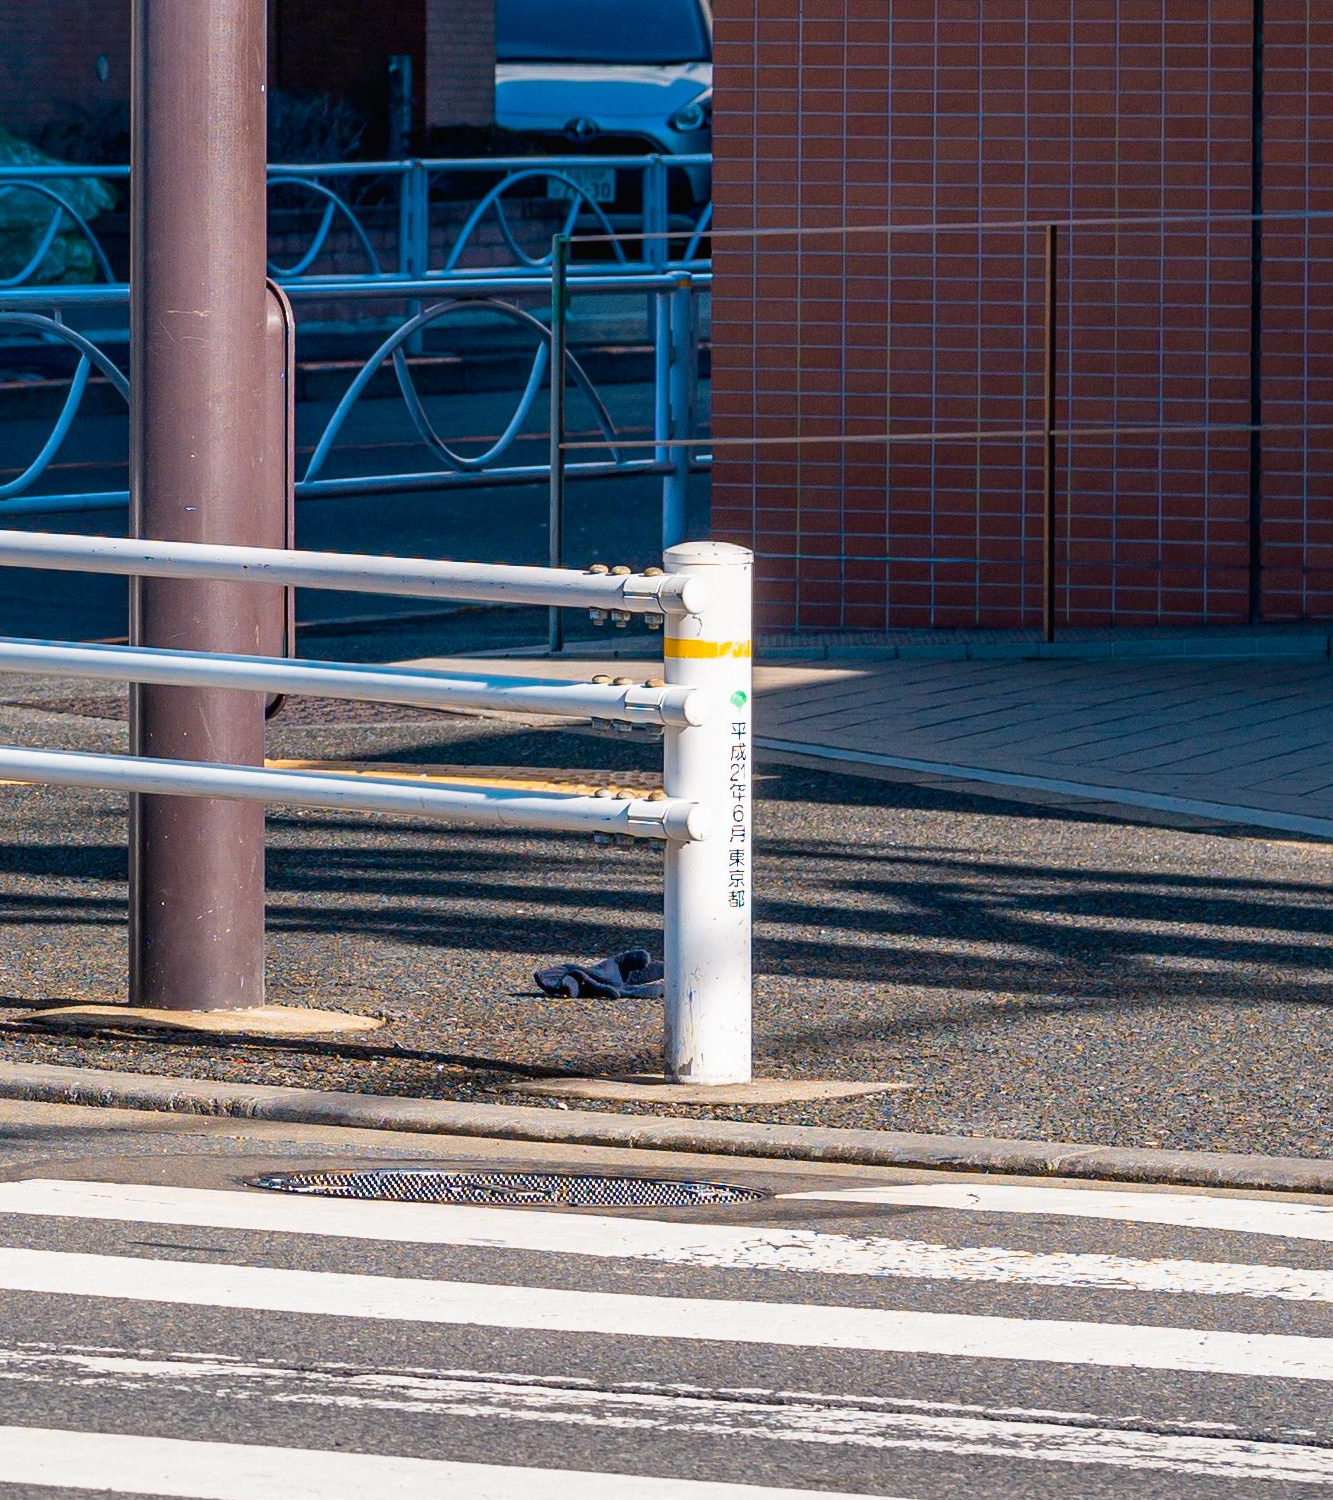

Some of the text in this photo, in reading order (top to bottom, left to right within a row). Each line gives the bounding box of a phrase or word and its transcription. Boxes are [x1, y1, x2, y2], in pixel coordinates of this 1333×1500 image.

[727, 721, 747, 908] 平成21年6月 東京都
